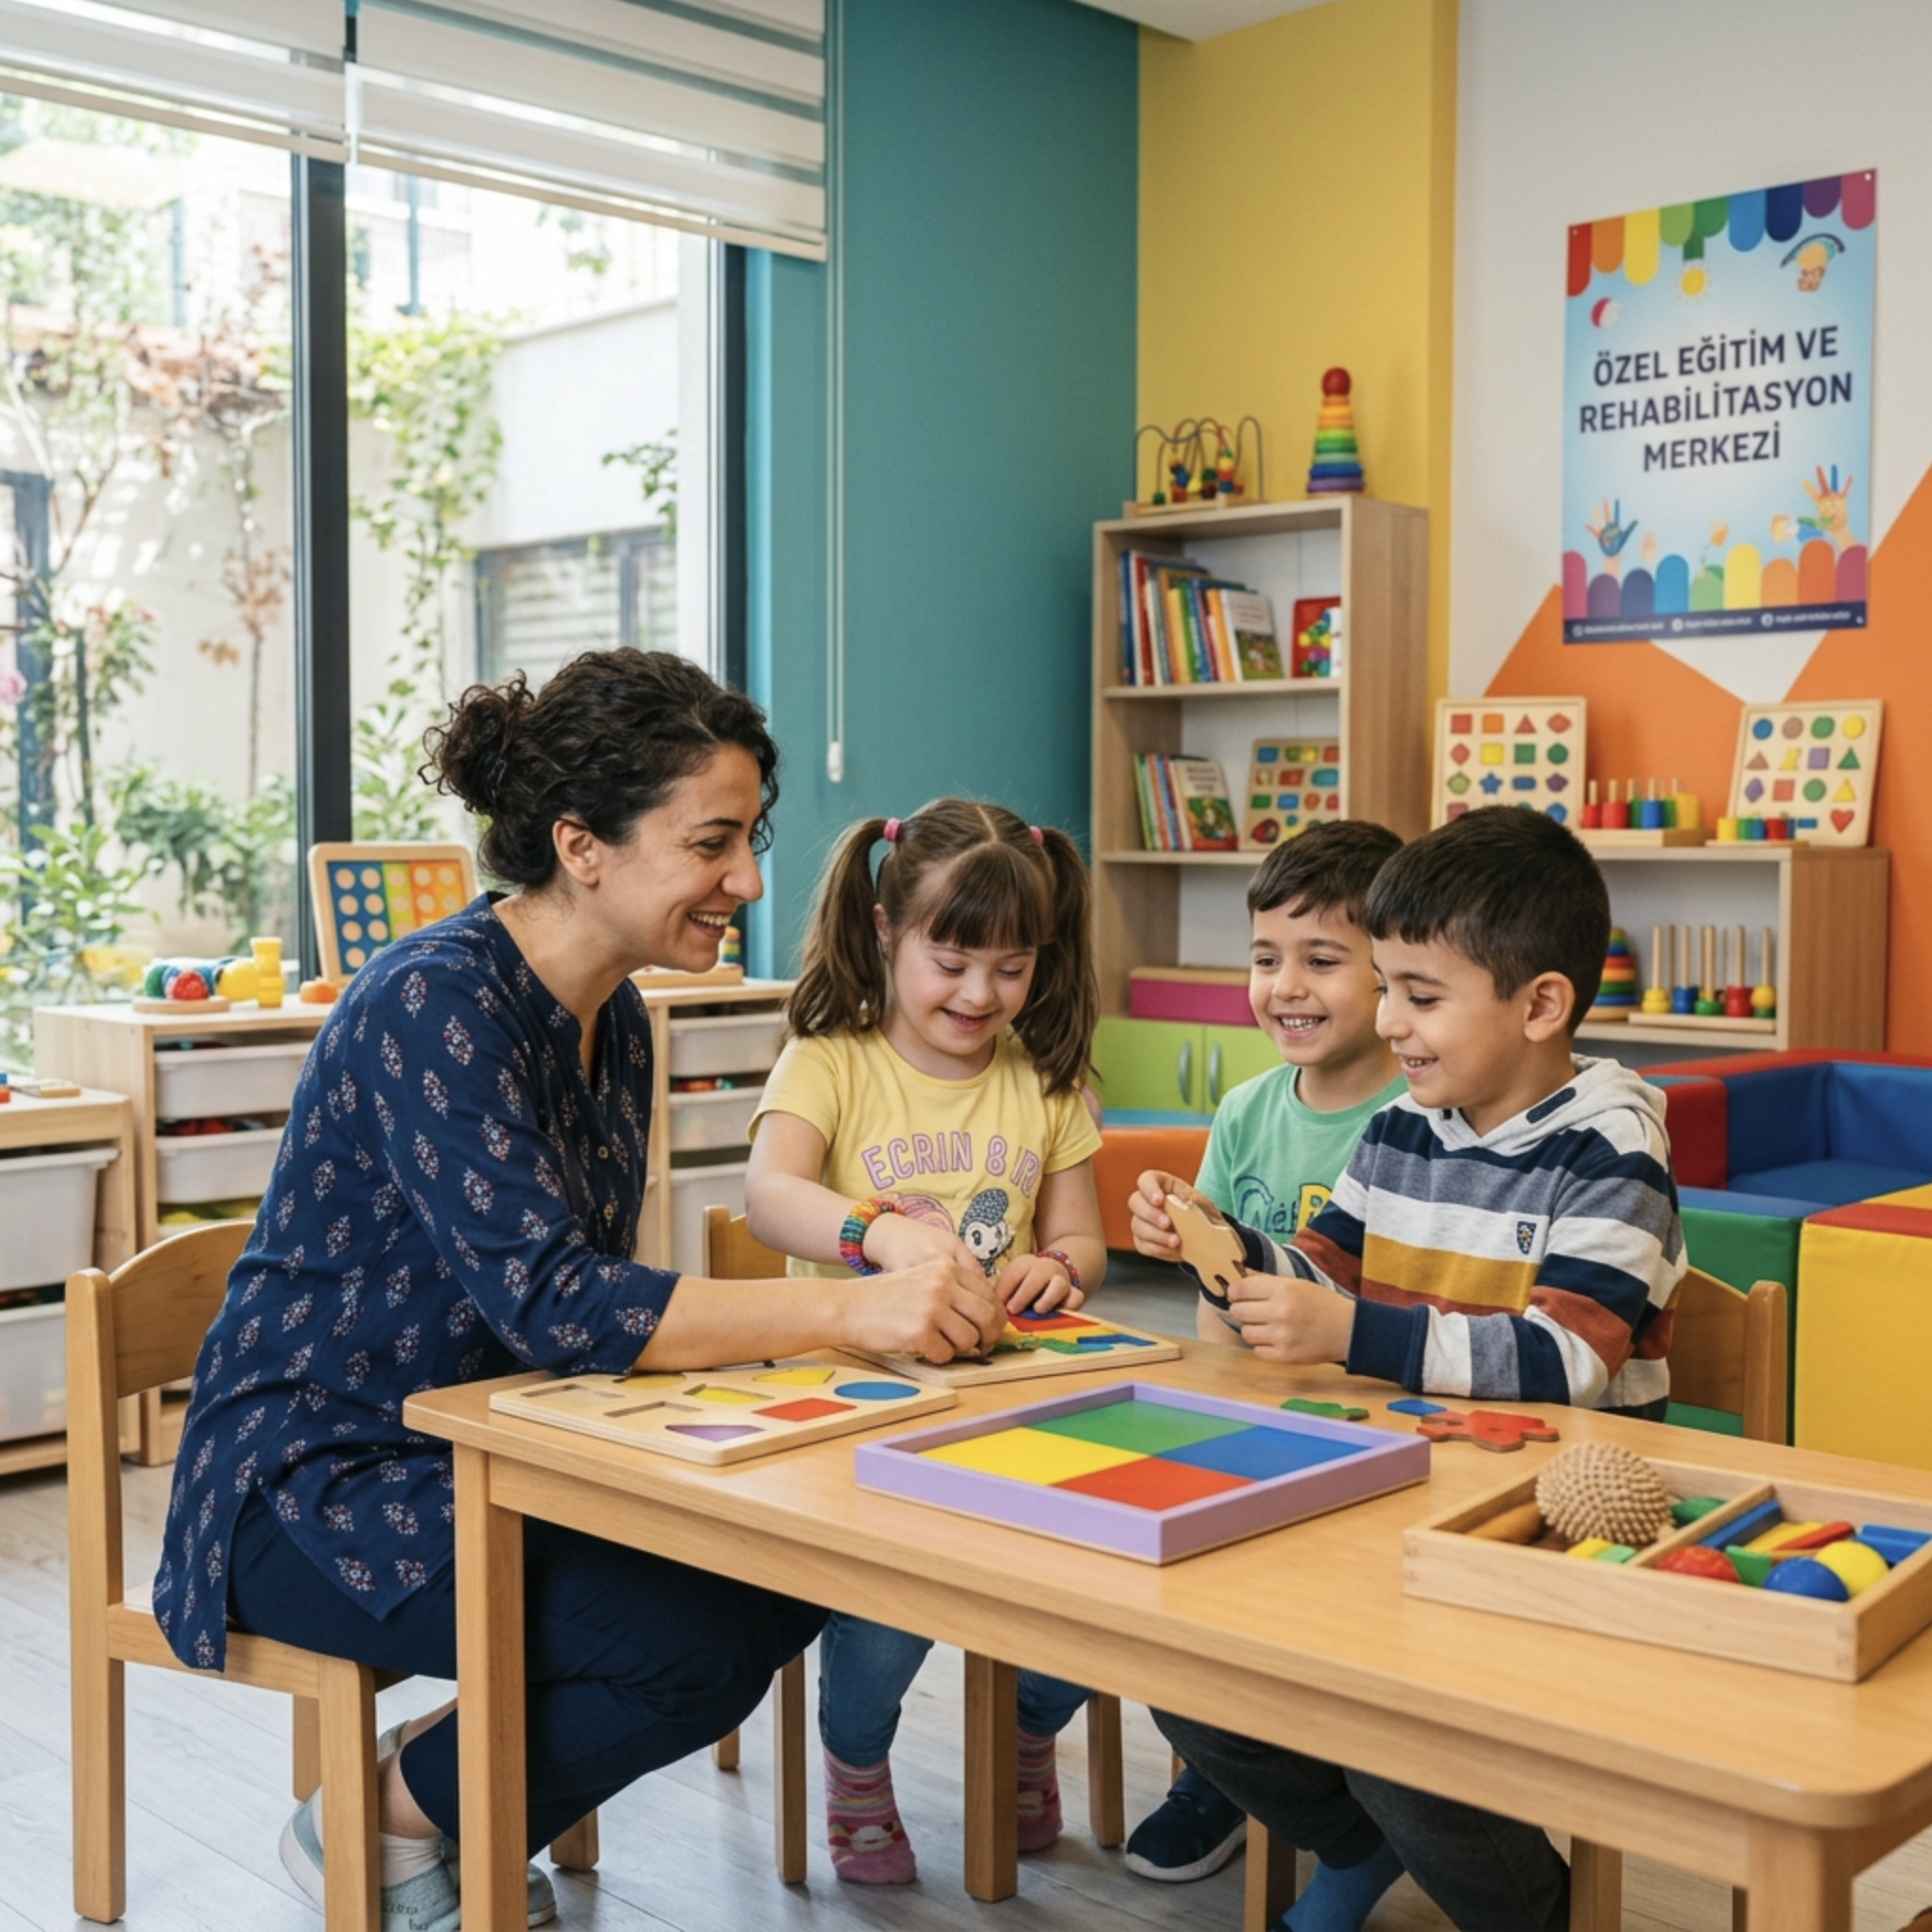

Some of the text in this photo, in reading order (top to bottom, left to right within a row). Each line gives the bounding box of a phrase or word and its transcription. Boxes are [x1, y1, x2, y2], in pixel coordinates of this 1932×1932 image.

[1594, 325, 1838, 388] ÖZEL EĞİTİM VE
[1579, 371, 1853, 434] REHABİLİTASYON
[1643, 421, 1780, 473] MERKEZİ
[861, 1131, 973, 1191] ECRIN
